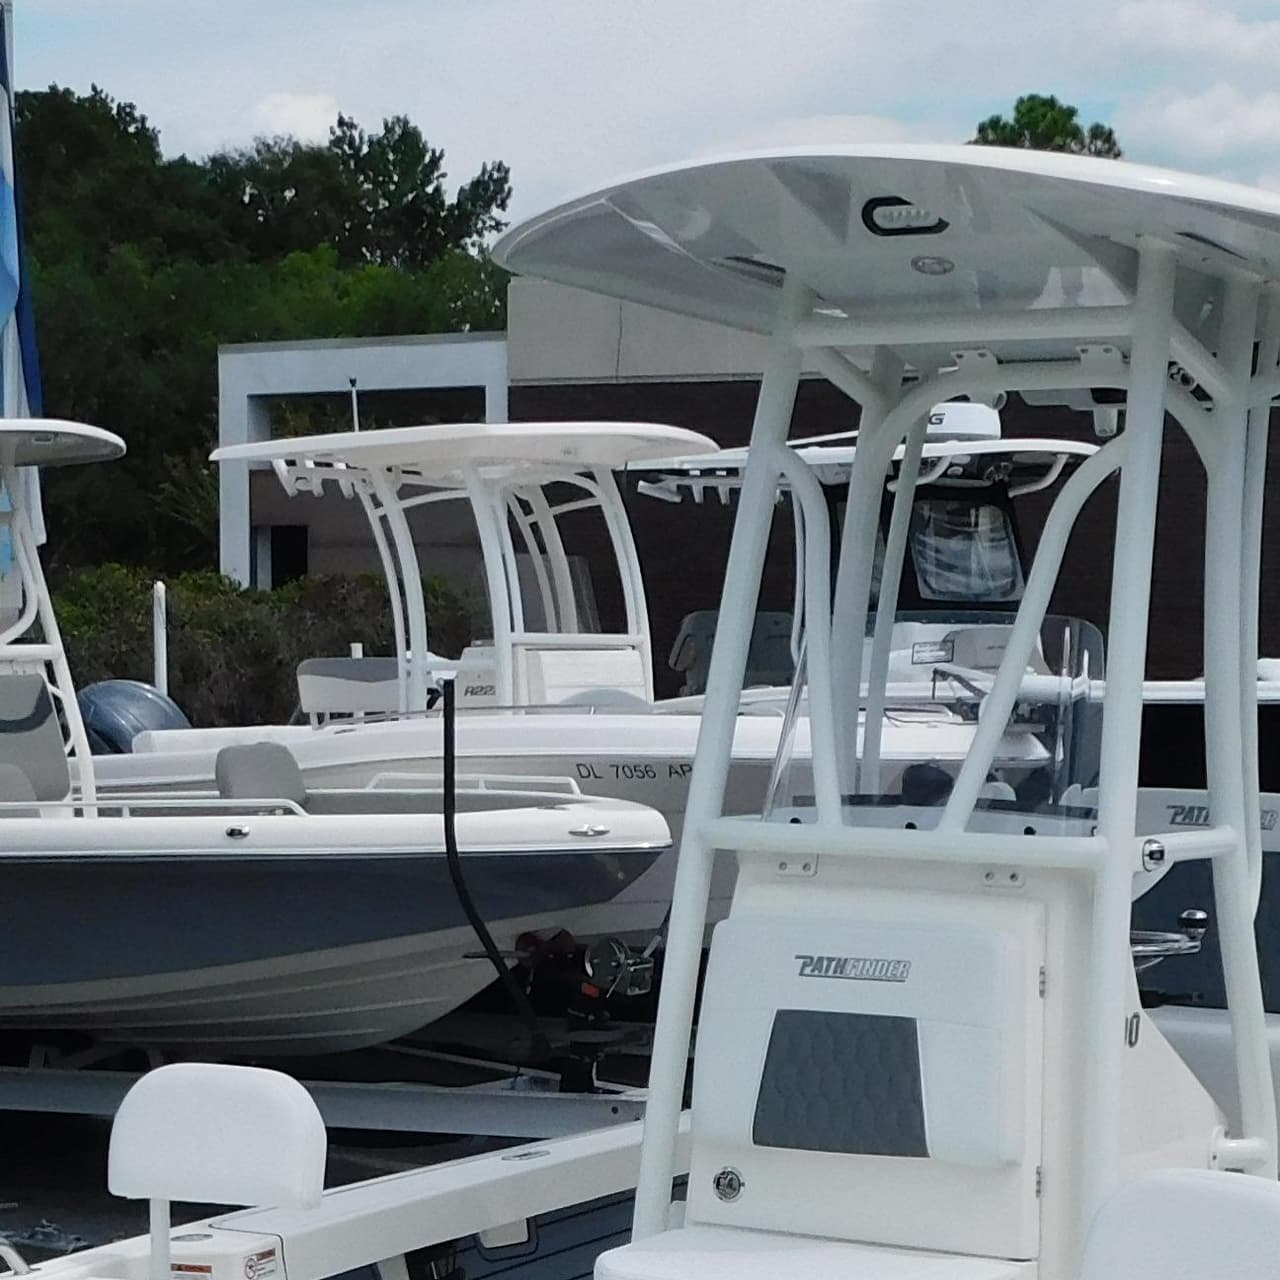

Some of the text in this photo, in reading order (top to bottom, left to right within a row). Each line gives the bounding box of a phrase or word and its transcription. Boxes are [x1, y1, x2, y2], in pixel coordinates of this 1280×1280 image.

[576, 763, 693, 780] DL 7056 AP
[794, 954, 912, 983] PATHFINDER
